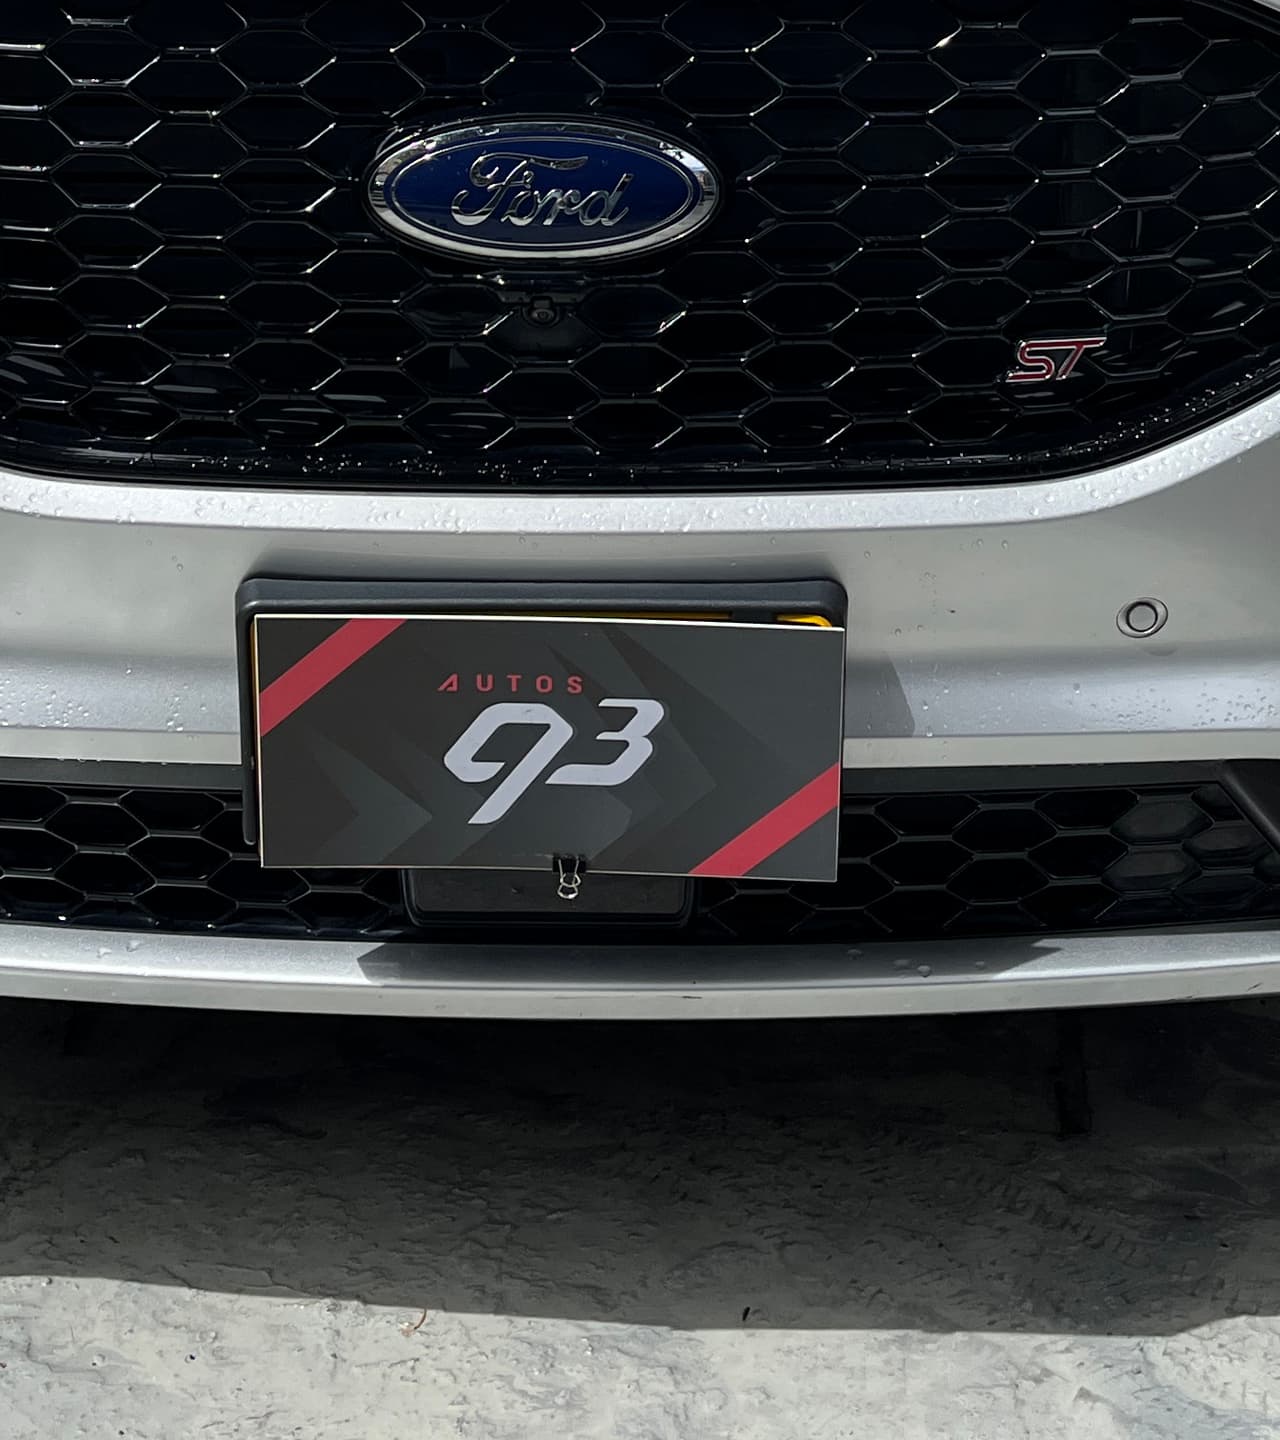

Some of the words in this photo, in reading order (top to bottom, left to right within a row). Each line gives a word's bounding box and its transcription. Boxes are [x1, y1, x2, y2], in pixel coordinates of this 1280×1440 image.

[451, 152, 634, 225] Ford
[1005, 337, 1107, 382] ST
[437, 674, 584, 695] AUTOS
[444, 698, 664, 825] 93
